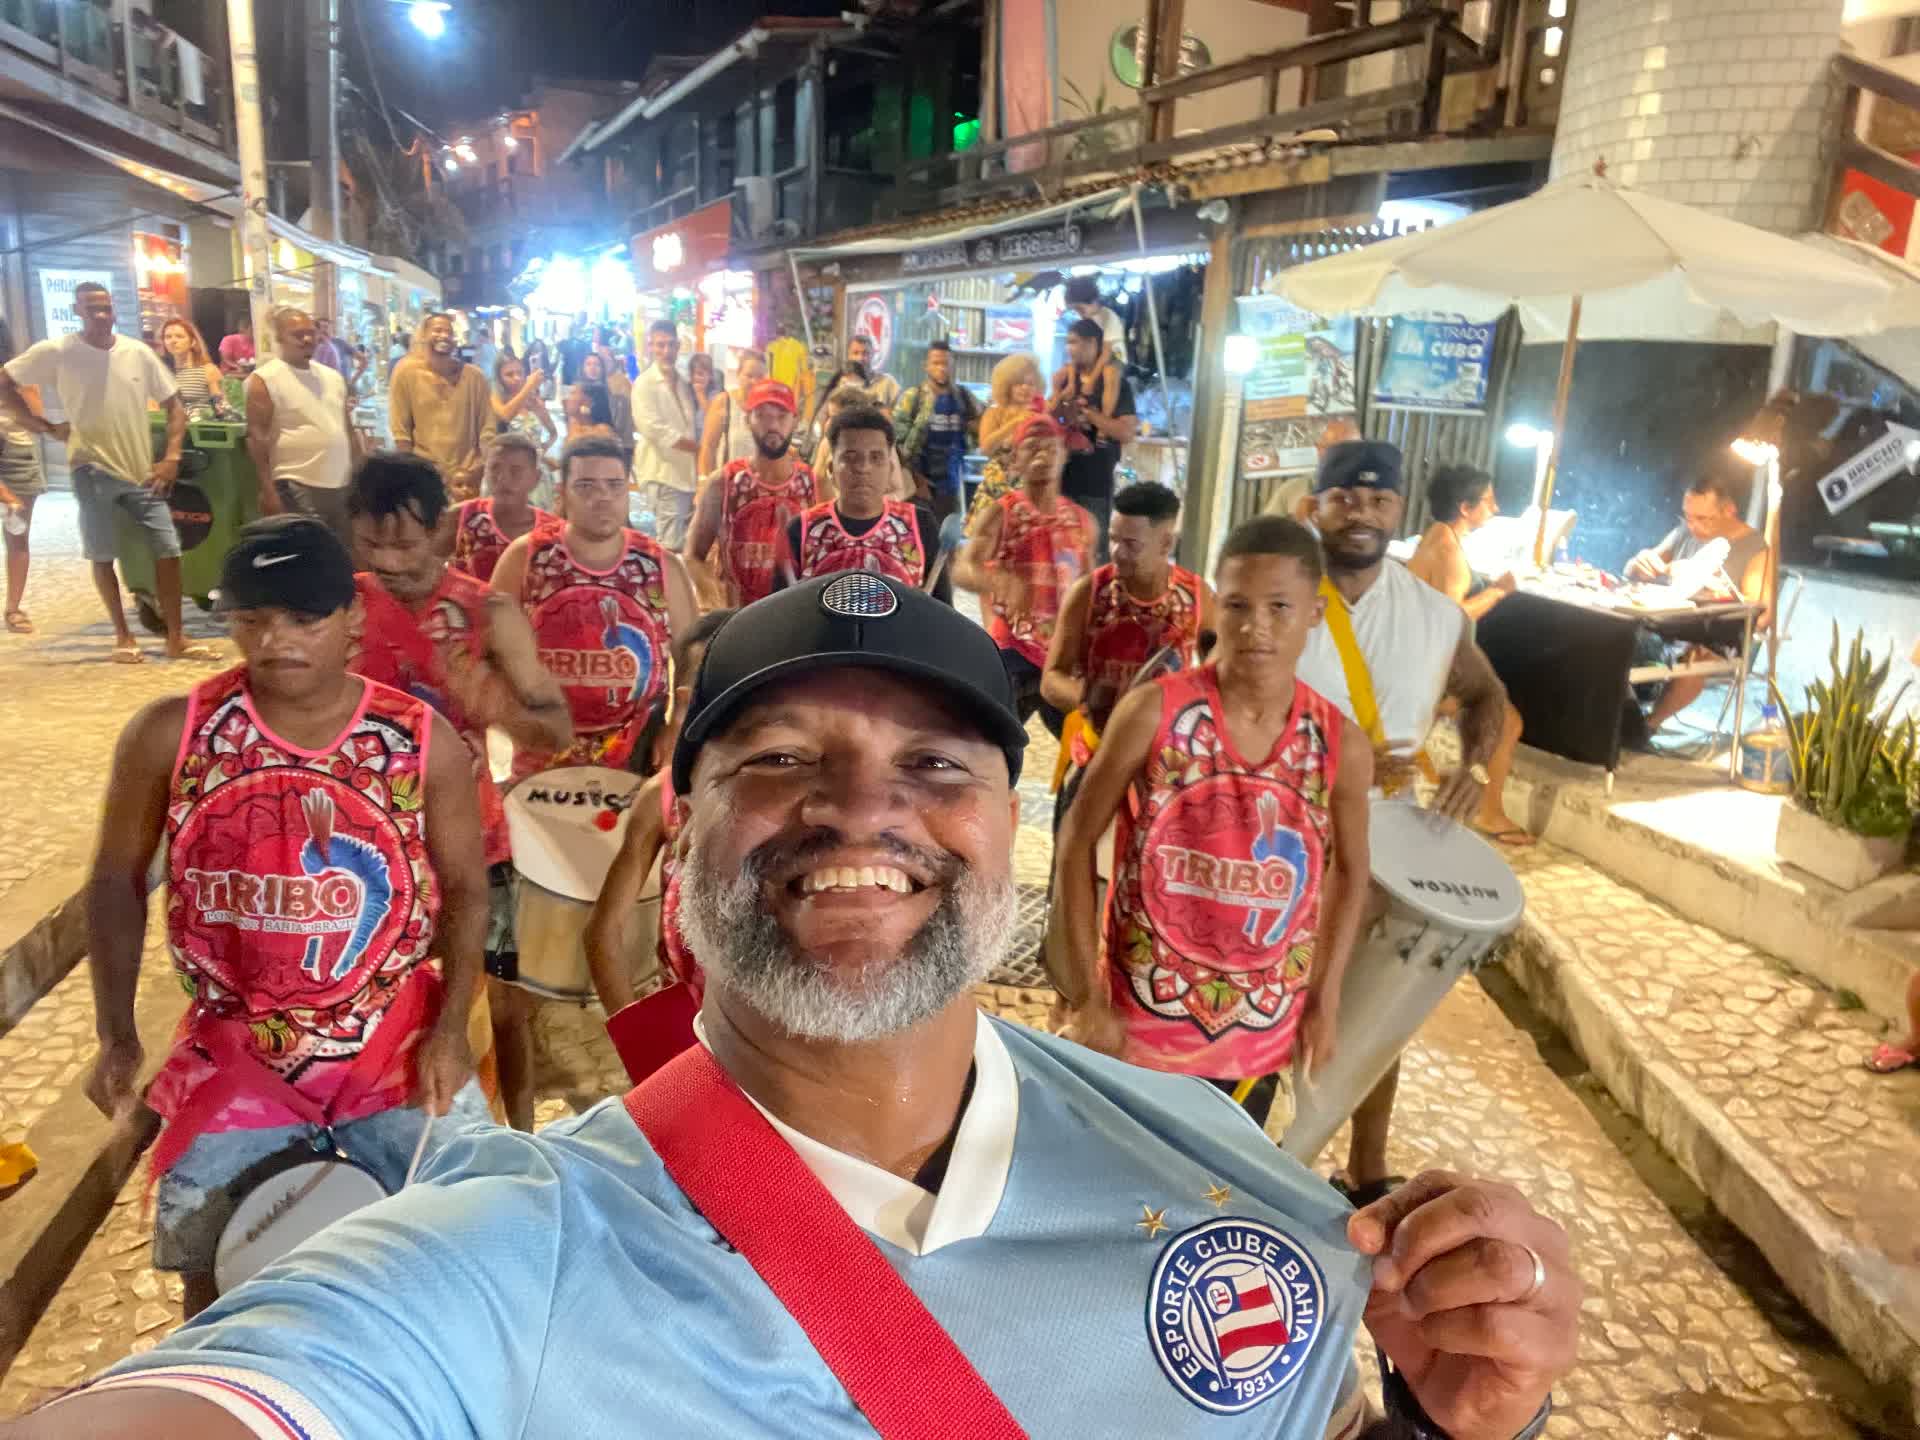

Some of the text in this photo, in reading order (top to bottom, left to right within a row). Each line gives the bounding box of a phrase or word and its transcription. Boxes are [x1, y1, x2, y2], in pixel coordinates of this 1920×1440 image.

[184, 867, 360, 920] TRIBO
[1156, 844, 1294, 898] TRIBO
[1162, 1231, 1313, 1379] ESPORTE CLUBE BAHIA
[1233, 1370, 1276, 1400] 1931
